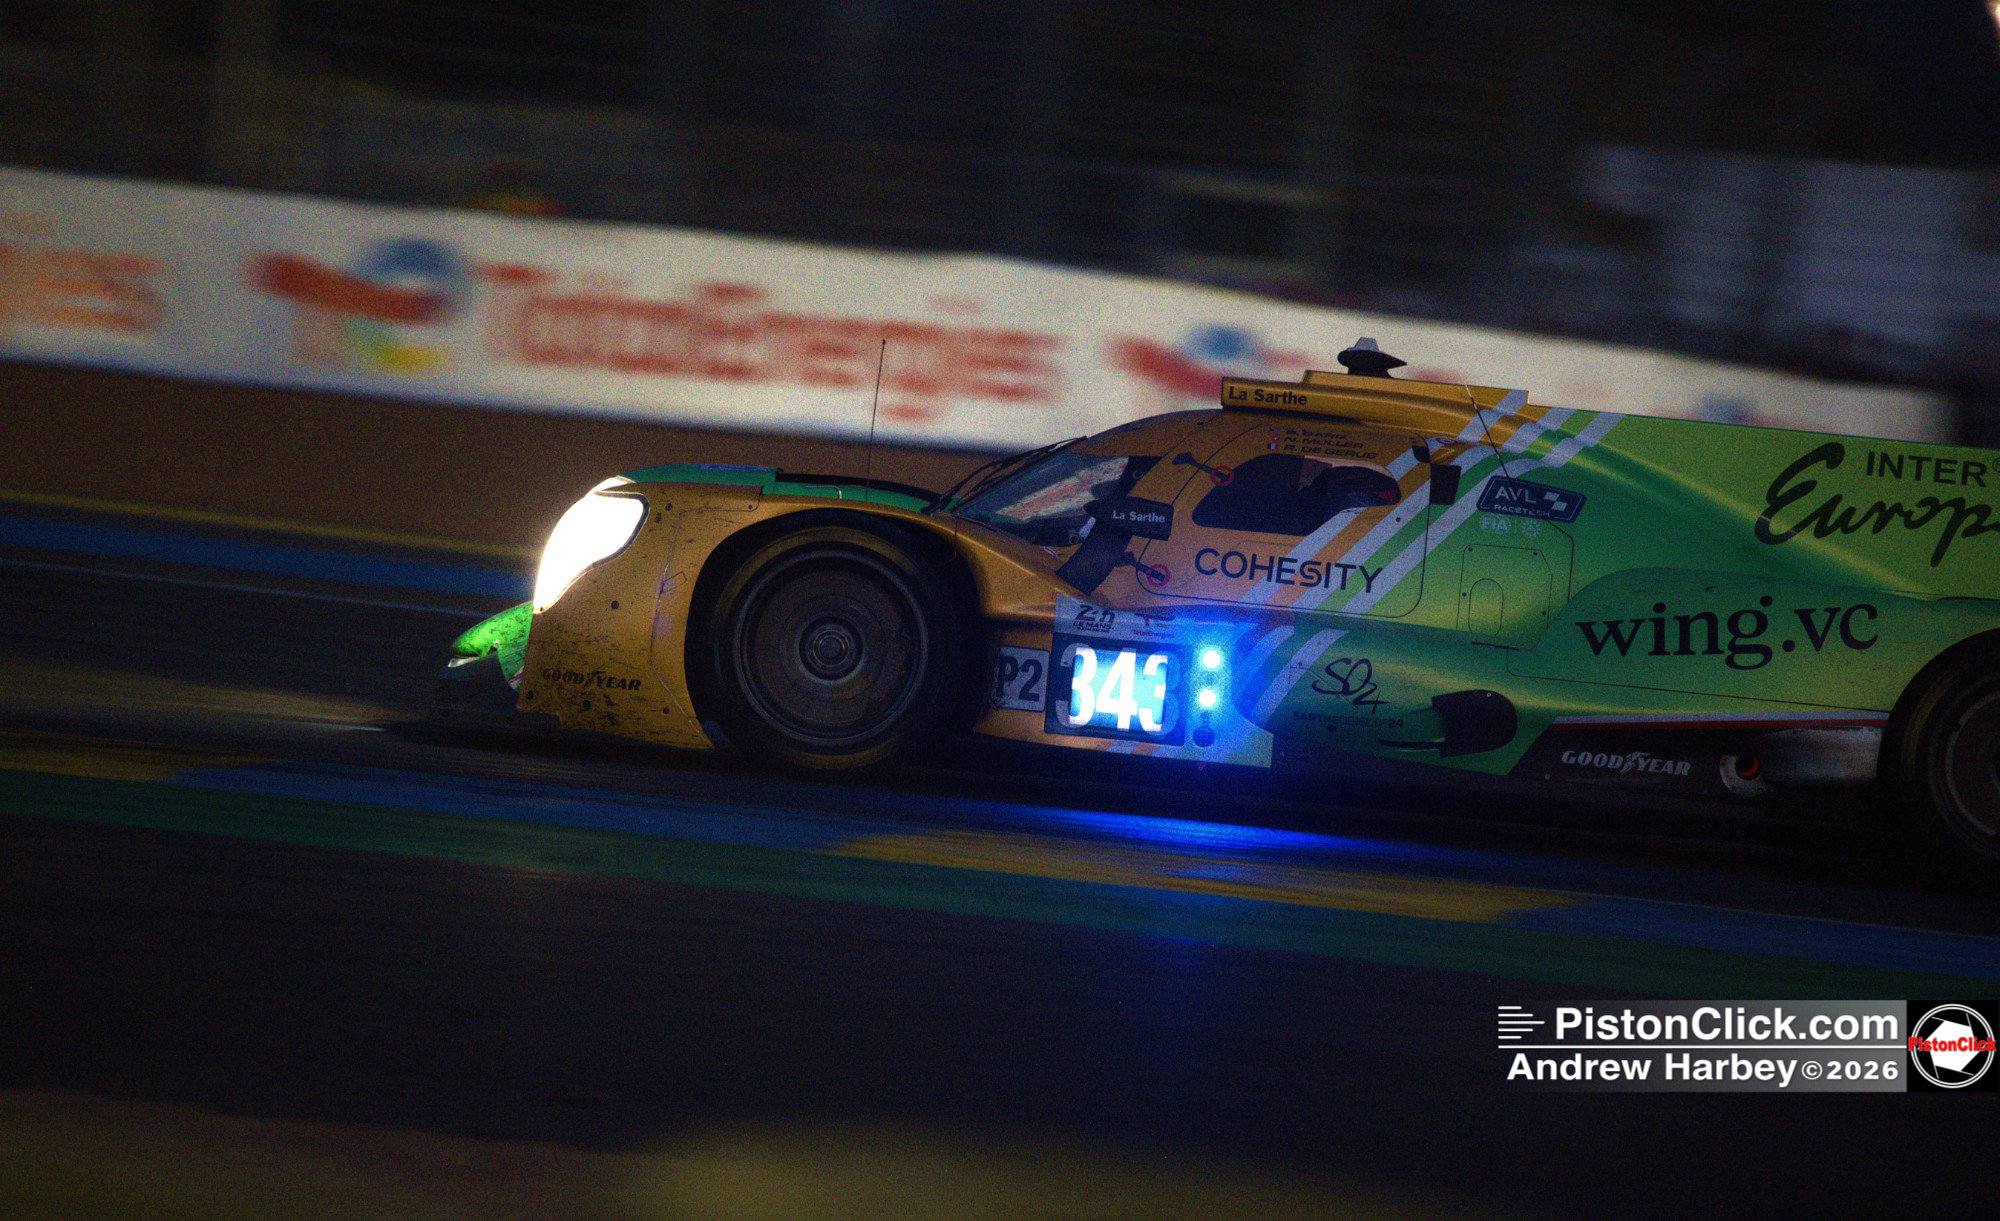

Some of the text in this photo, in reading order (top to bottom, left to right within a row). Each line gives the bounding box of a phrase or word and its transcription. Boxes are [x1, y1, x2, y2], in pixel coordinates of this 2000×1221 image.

[1228, 386, 1308, 406] La Sarthe
[1301, 445, 1322, 454] DE
[1866, 451, 1987, 488] INTER
[1495, 485, 1537, 504] AVL
[1754, 442, 2000, 568] Europ
[1112, 509, 1166, 524] La Sarthe
[1493, 504, 1551, 517] RACETECH
[1480, 516, 1508, 531] FIA
[1194, 547, 1384, 594] COHESITY
[1576, 594, 1879, 671] wing.vc
[542, 668, 642, 691] GOODYEAR
[1055, 642, 1181, 736] 343
[1561, 750, 1692, 776] GOODYEAR
